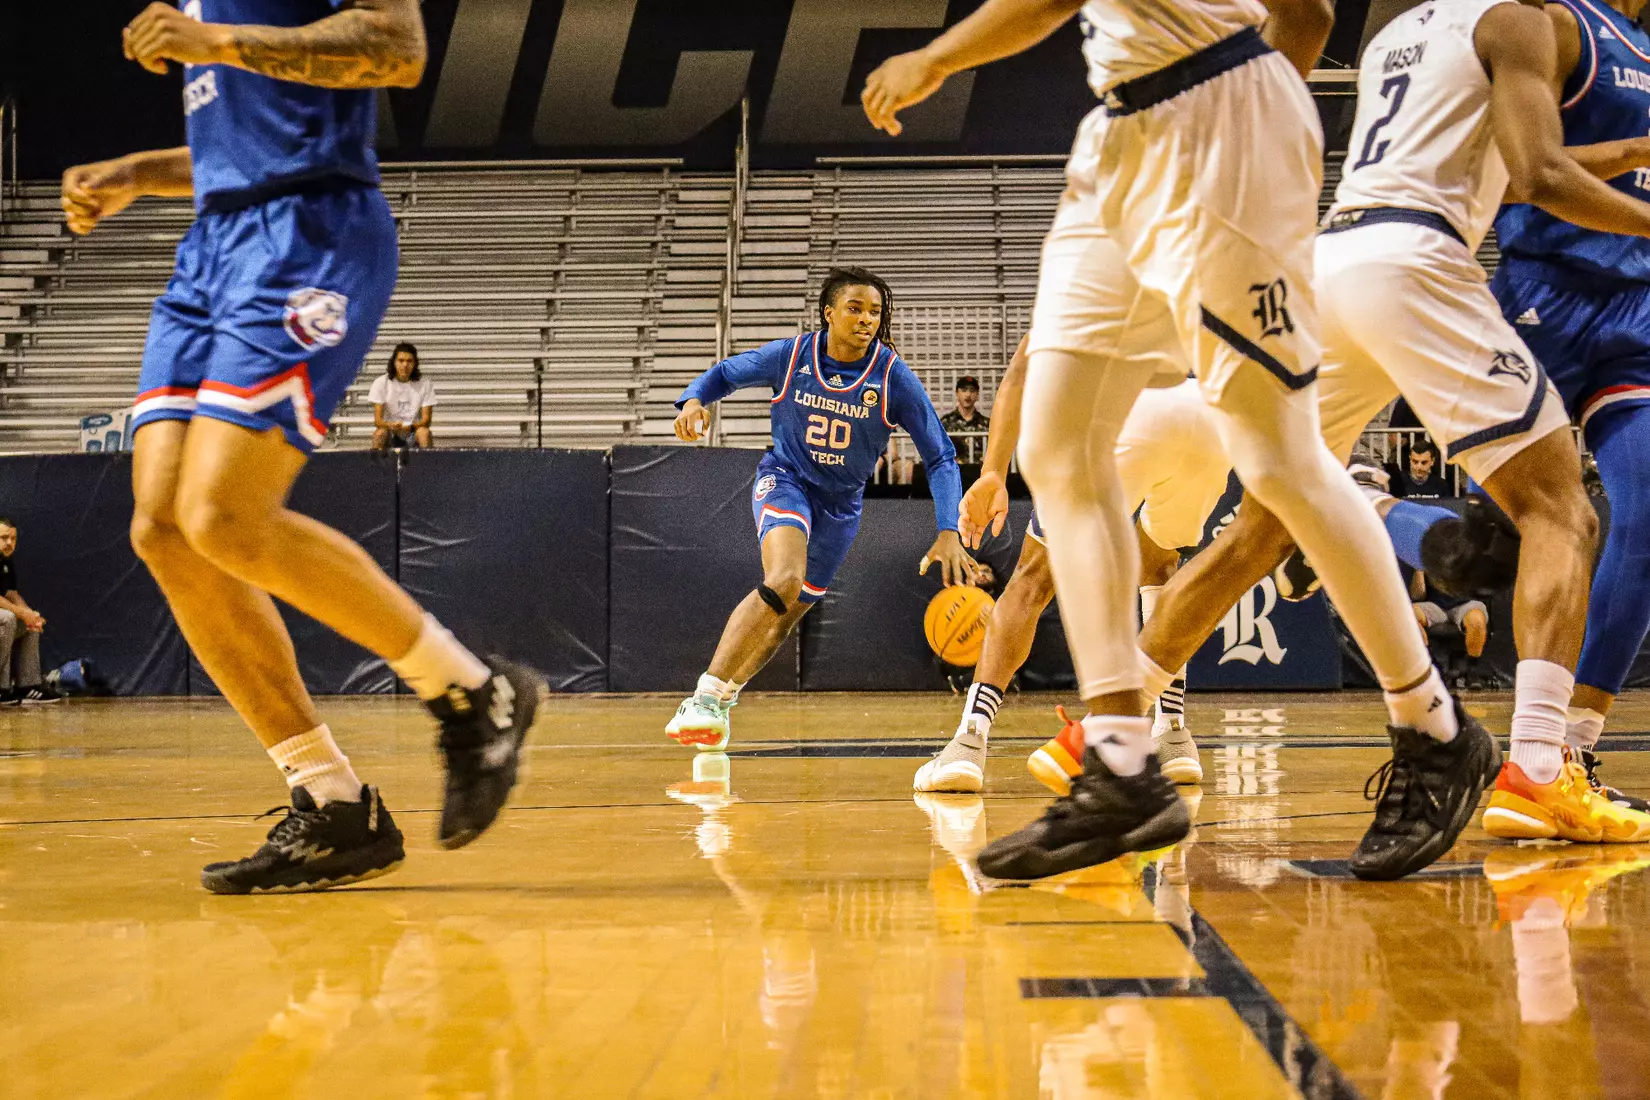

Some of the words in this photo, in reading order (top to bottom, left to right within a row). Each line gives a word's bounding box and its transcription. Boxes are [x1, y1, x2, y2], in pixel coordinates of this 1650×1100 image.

[1382, 40, 1428, 74] MASON
[1352, 72, 1411, 173] 2
[1249, 277, 1295, 340] R
[794, 389, 870, 419] LOUISIANA
[805, 413, 852, 450] 20
[809, 449, 845, 466] TECH
